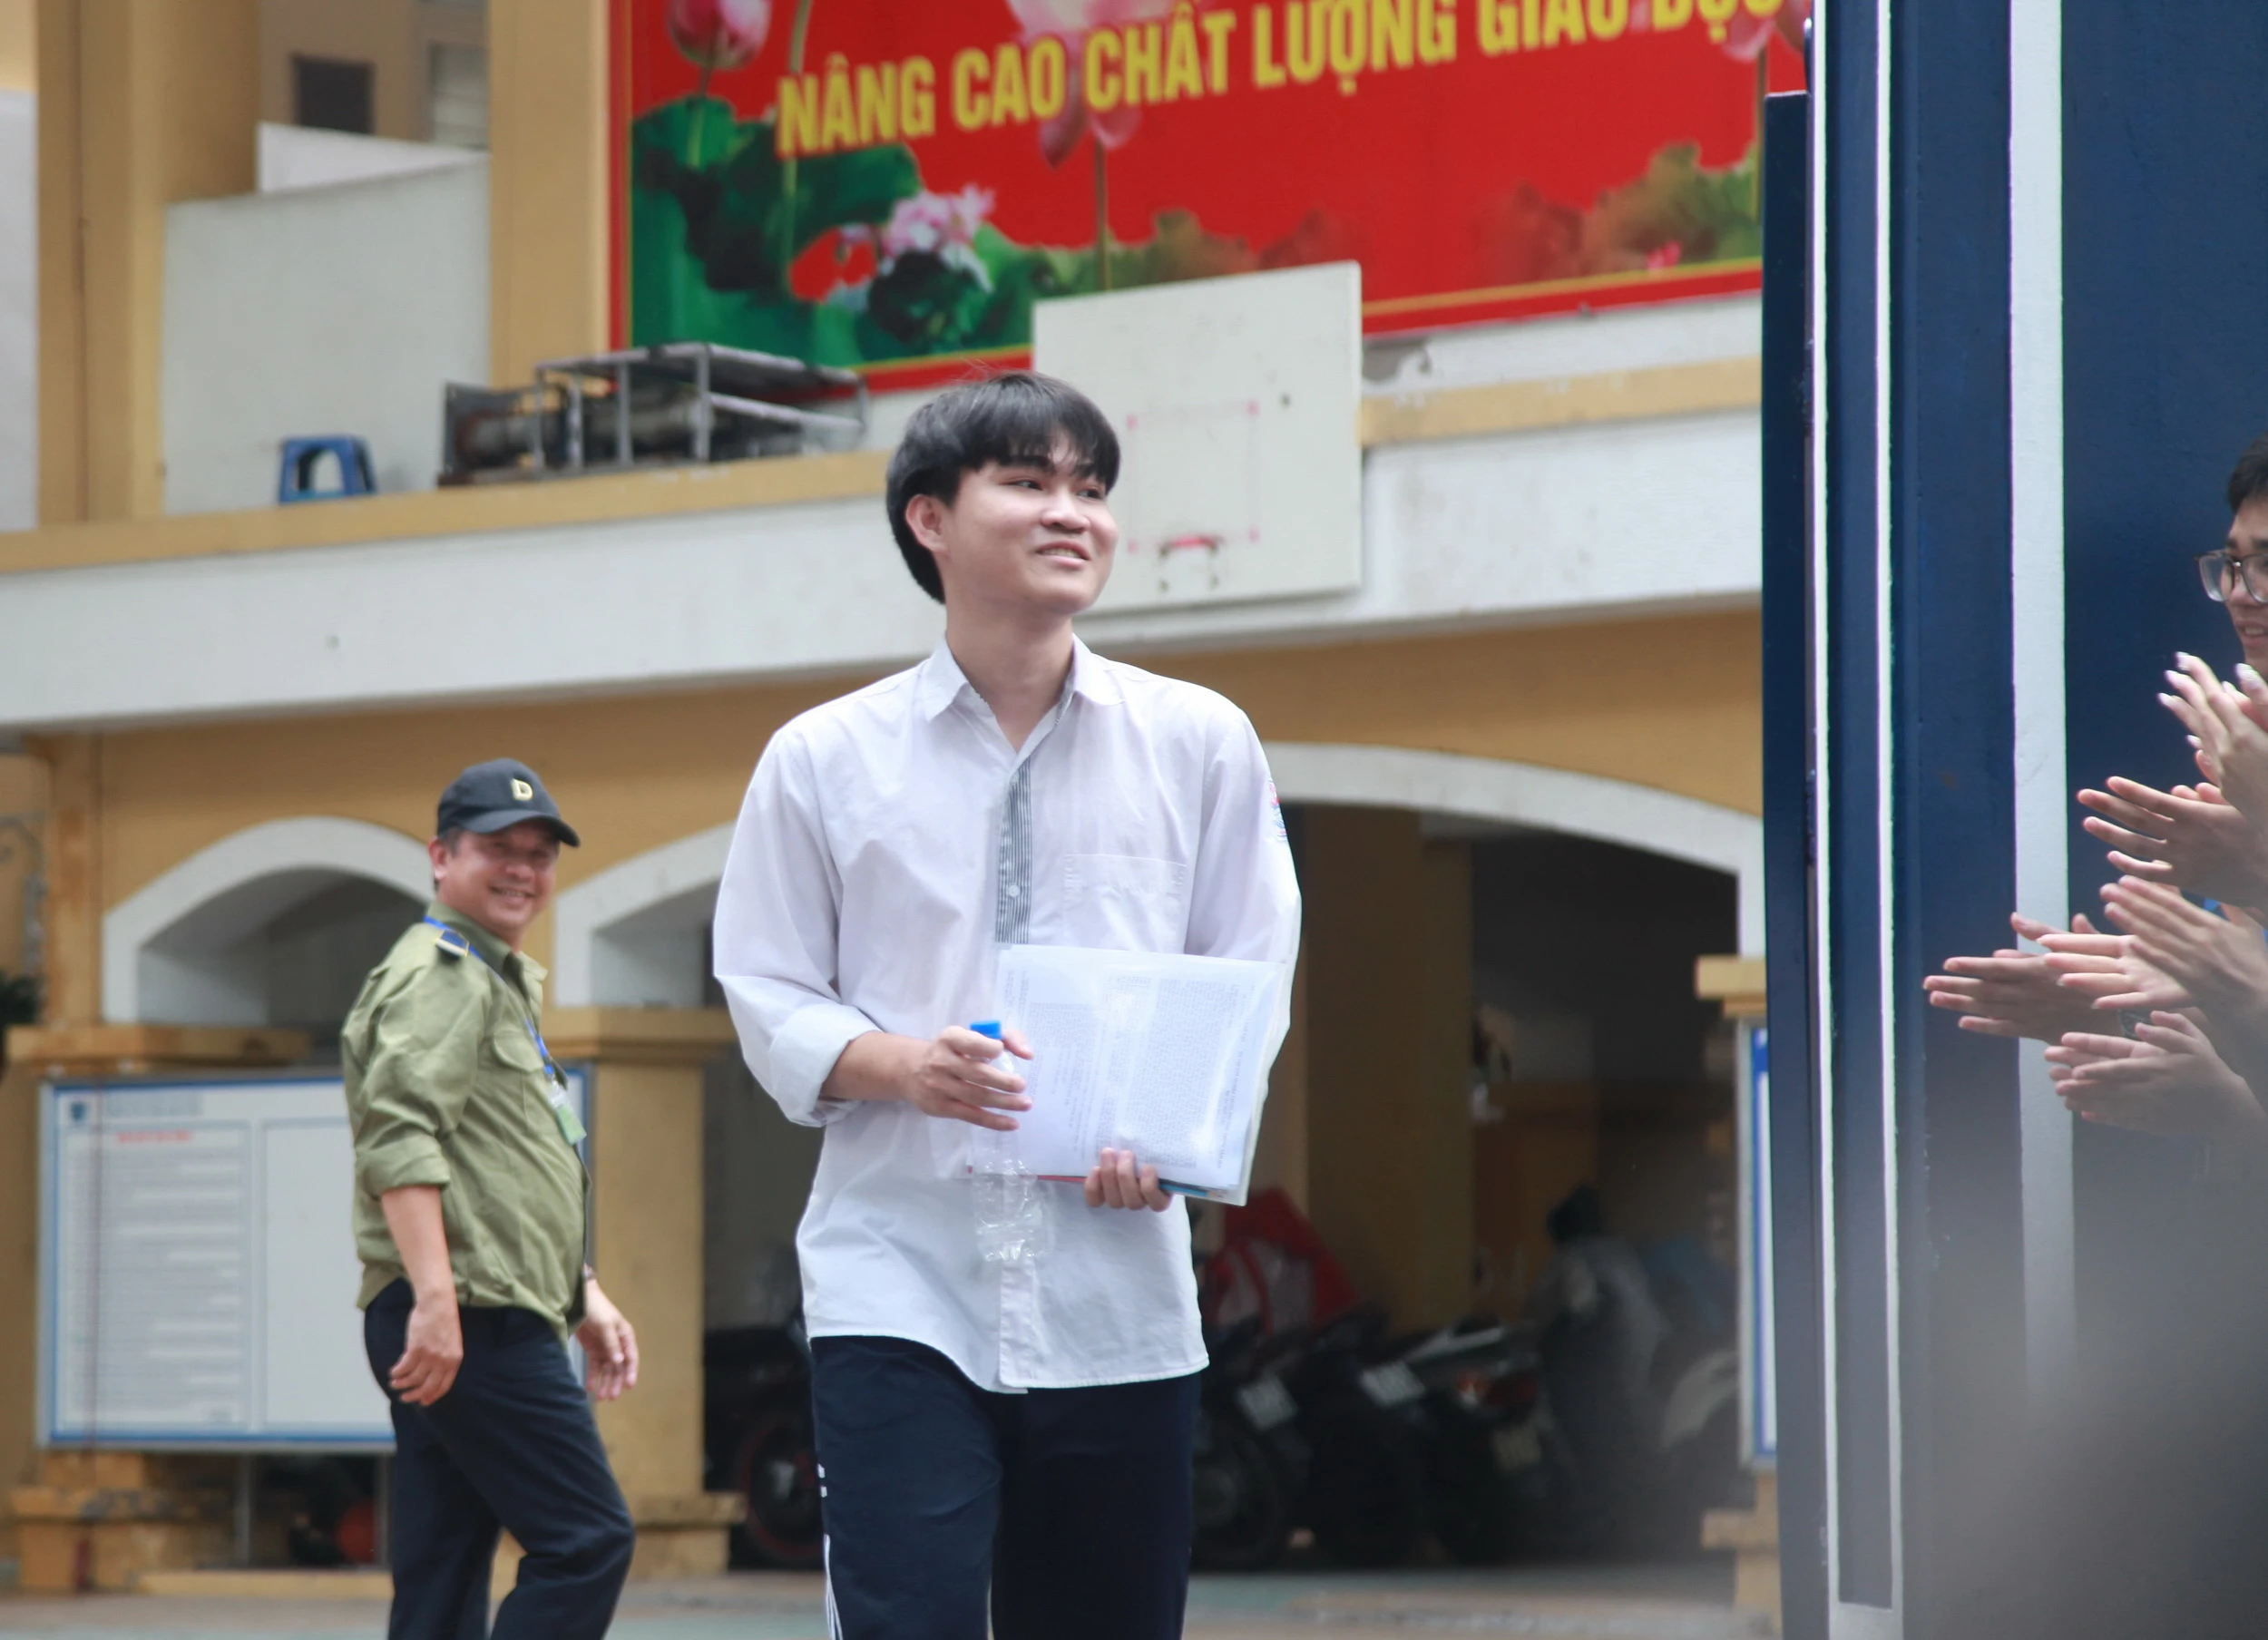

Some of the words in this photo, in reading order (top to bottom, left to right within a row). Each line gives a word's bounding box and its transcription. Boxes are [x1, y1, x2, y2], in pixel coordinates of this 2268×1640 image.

[777, 51, 936, 156] NÂNG
[951, 35, 1066, 130] CAO
[1085, 0, 1237, 112] CHẤT
